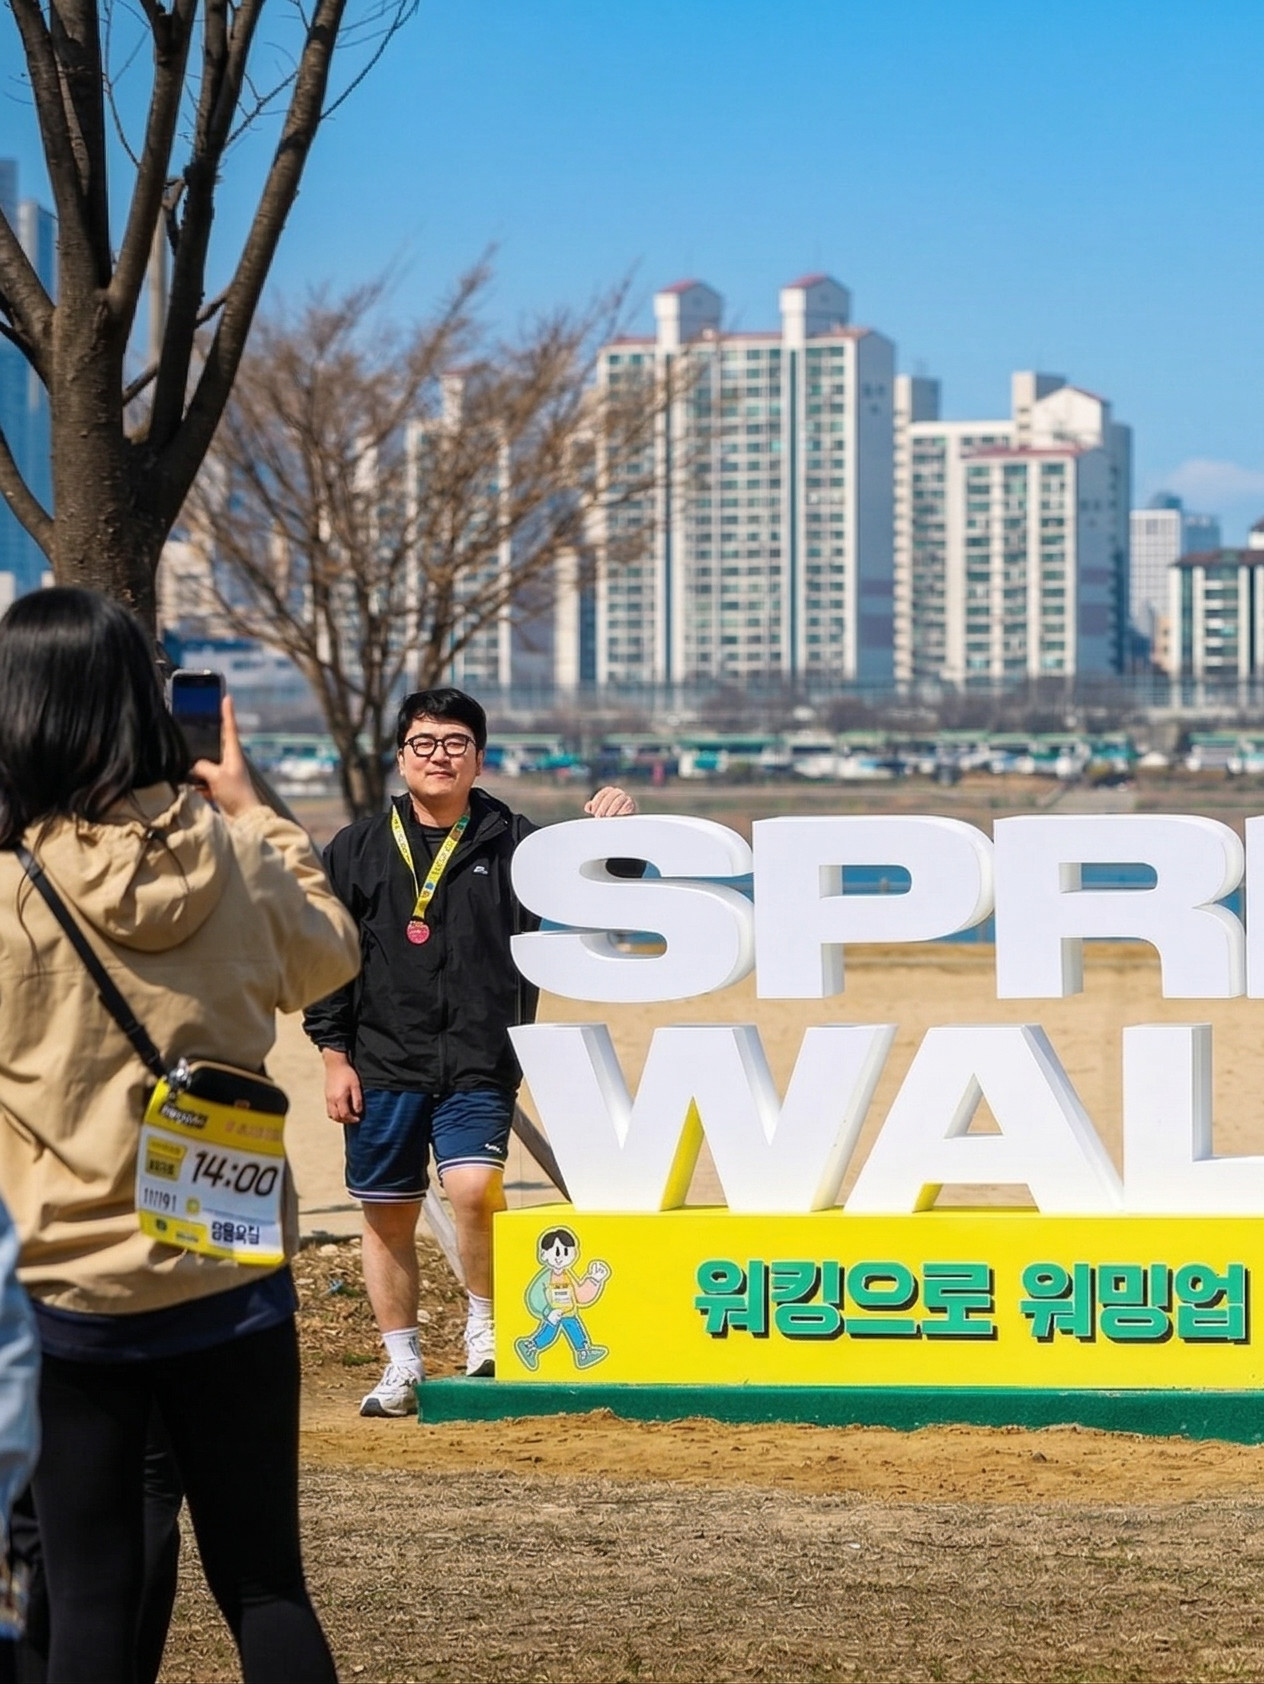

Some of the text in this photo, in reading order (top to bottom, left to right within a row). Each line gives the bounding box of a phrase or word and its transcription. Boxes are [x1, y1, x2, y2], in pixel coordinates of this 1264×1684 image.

[192, 1150, 279, 1197] 14:00
[693, 1260, 1252, 1345] 워킹으로 워밍업
